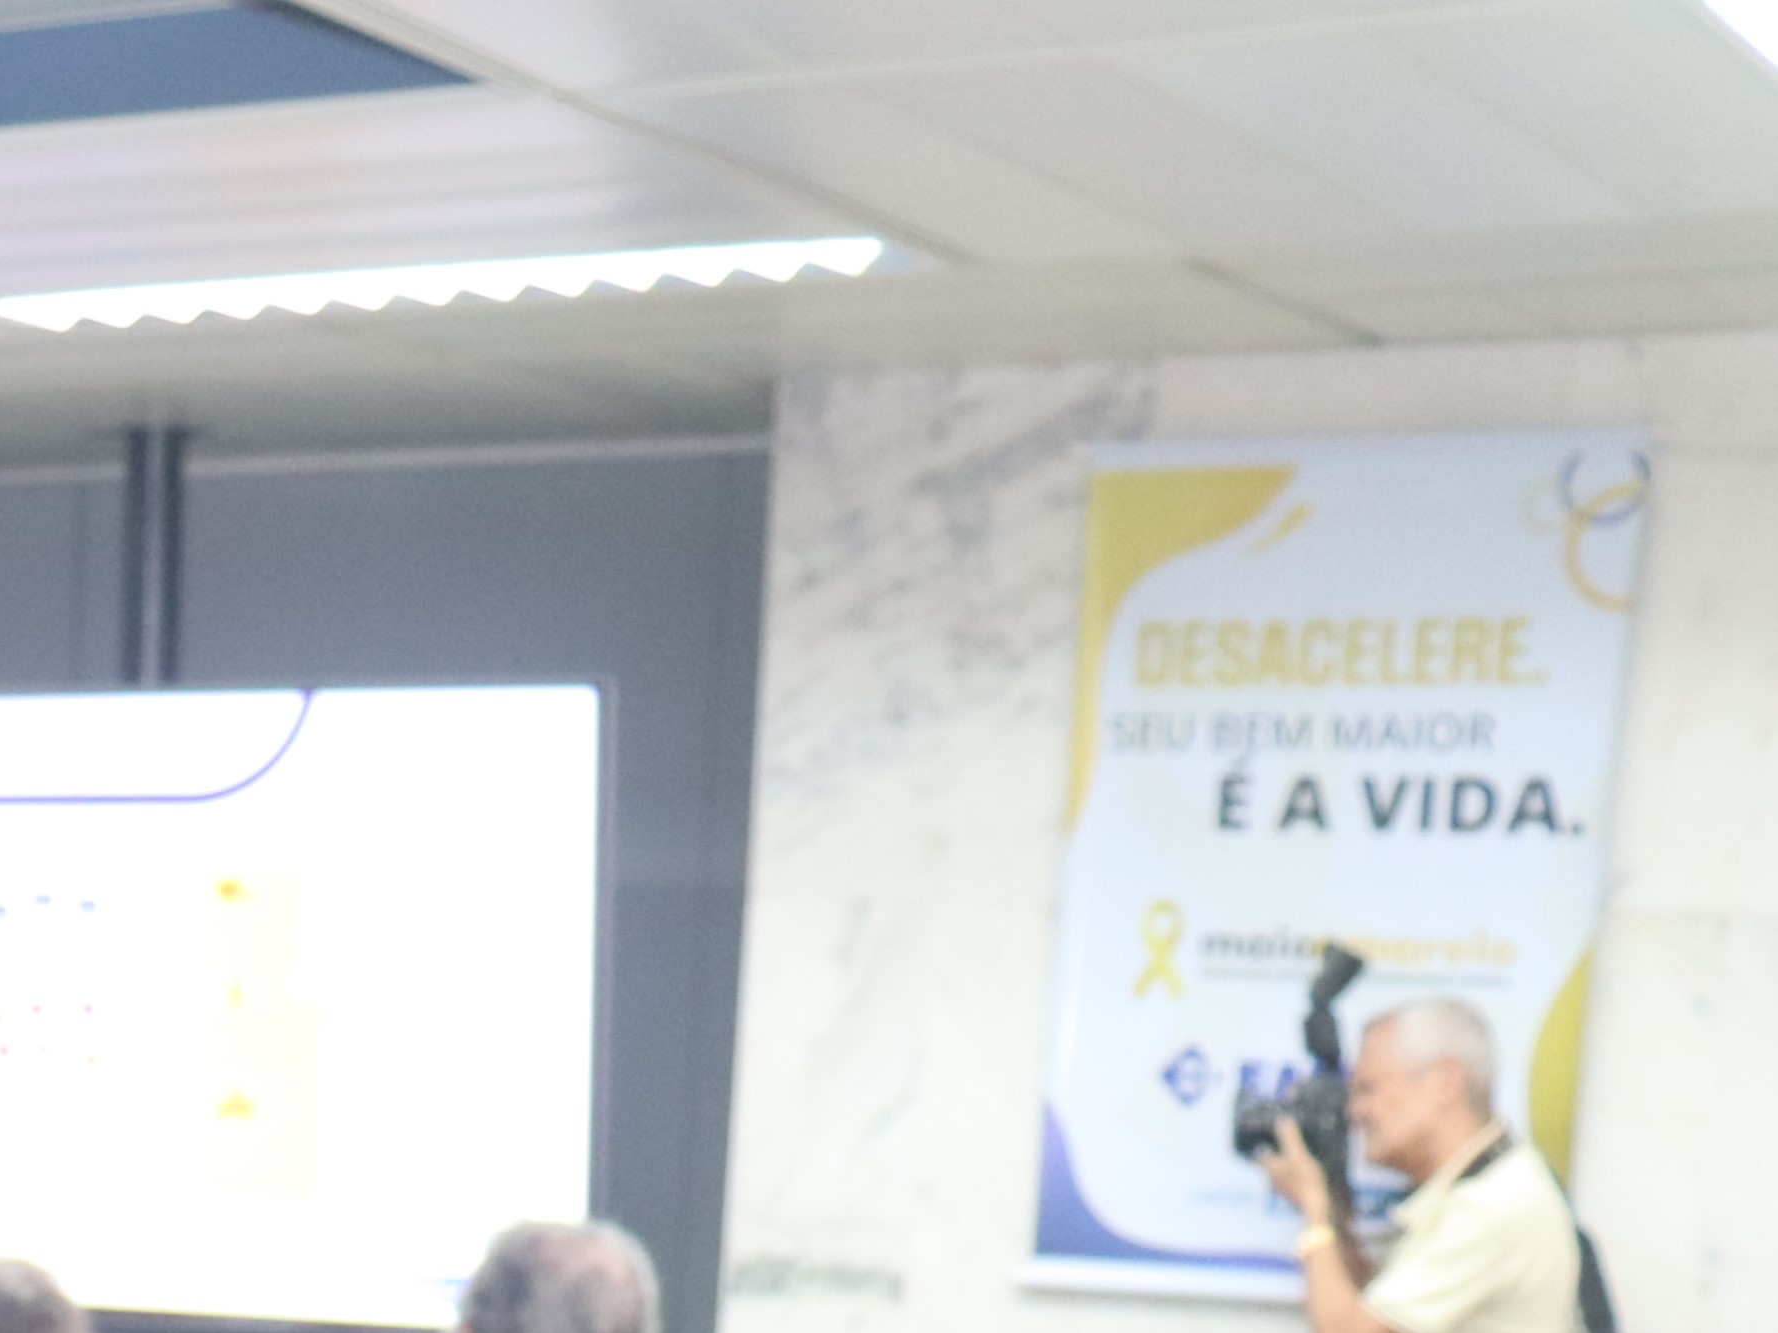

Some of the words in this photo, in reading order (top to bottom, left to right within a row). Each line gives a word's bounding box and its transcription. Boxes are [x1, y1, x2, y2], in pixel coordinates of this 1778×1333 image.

[1136, 617, 1549, 685] DESACELERE.
[1111, 712, 1195, 750] SEU
[1212, 712, 1313, 750] BEM
[1333, 712, 1495, 750] MAIOR
[1217, 753, 1253, 829] É
[1279, 774, 1327, 830] A
[1362, 774, 1584, 835] VIDA.
